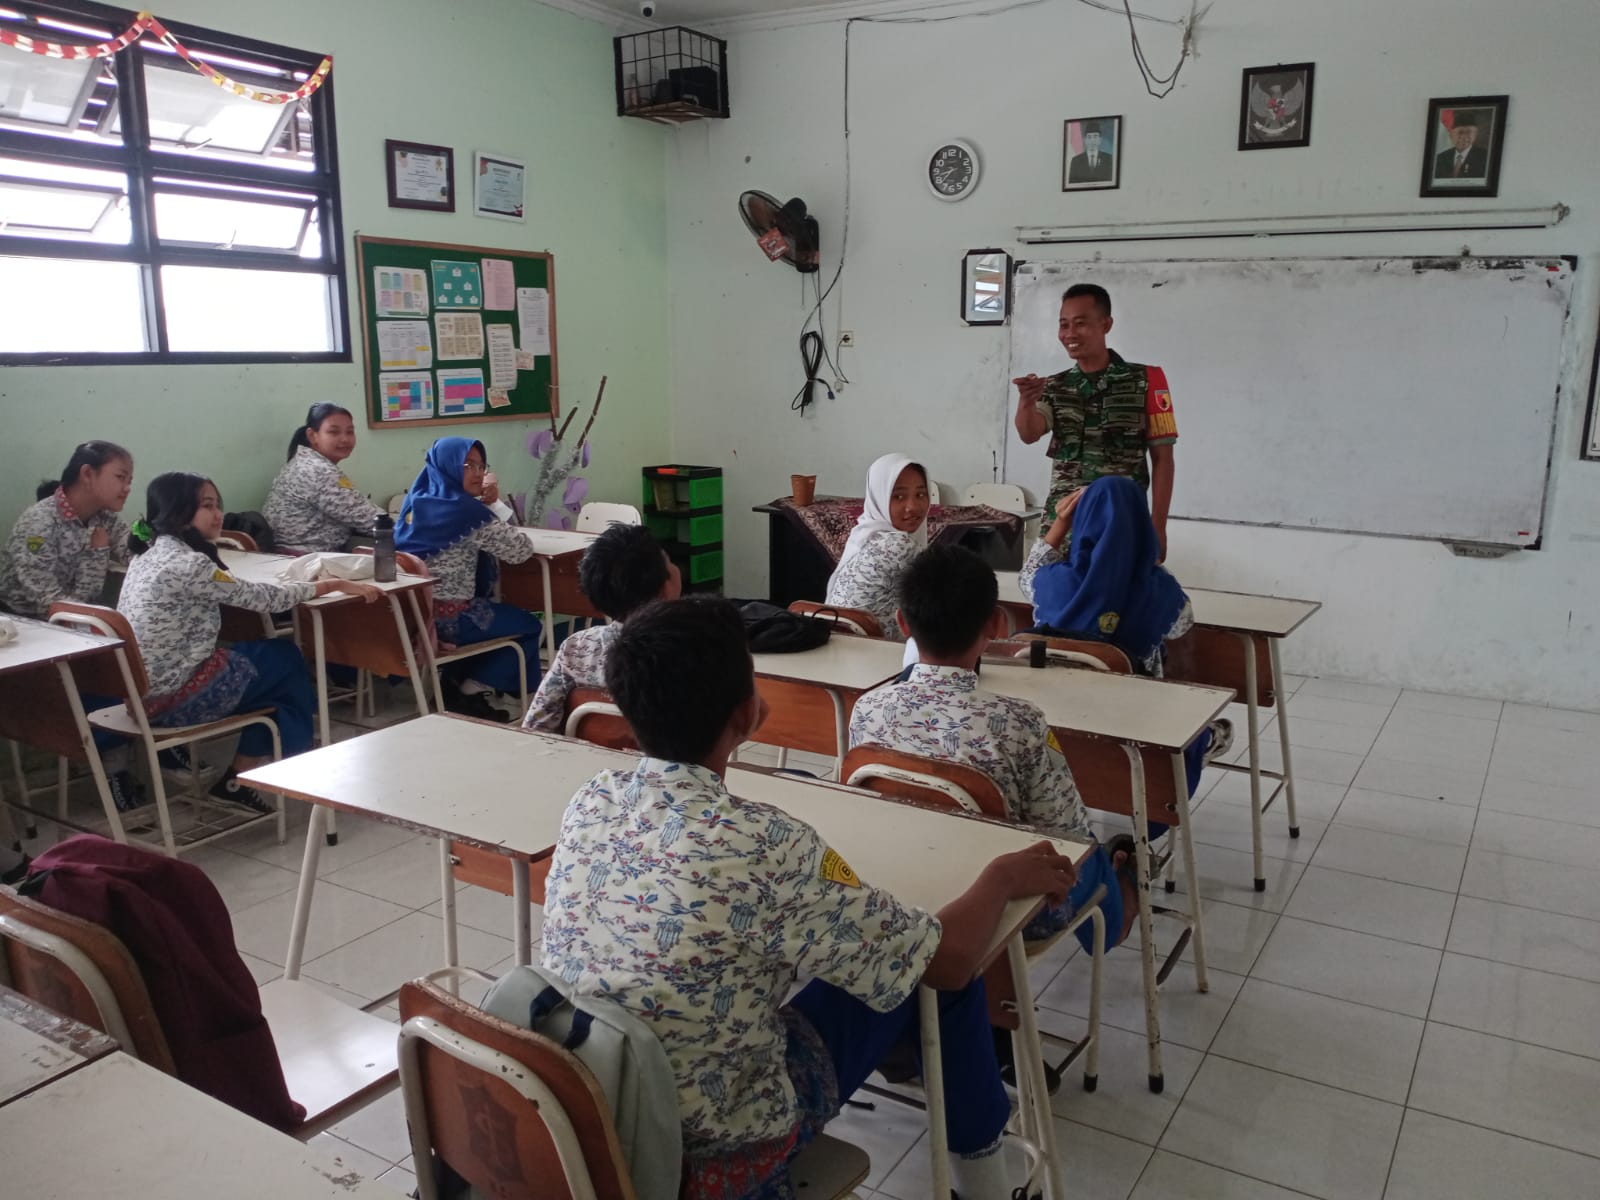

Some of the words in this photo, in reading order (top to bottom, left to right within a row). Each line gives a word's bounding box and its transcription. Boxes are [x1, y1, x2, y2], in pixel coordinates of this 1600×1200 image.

[947, 149, 957, 157] 12
[963, 158, 970, 166] 2
[935, 176, 943, 184] 8
[948, 185, 955, 193] 6
[956, 182, 963, 190] 5
[842, 866, 850, 876] B
